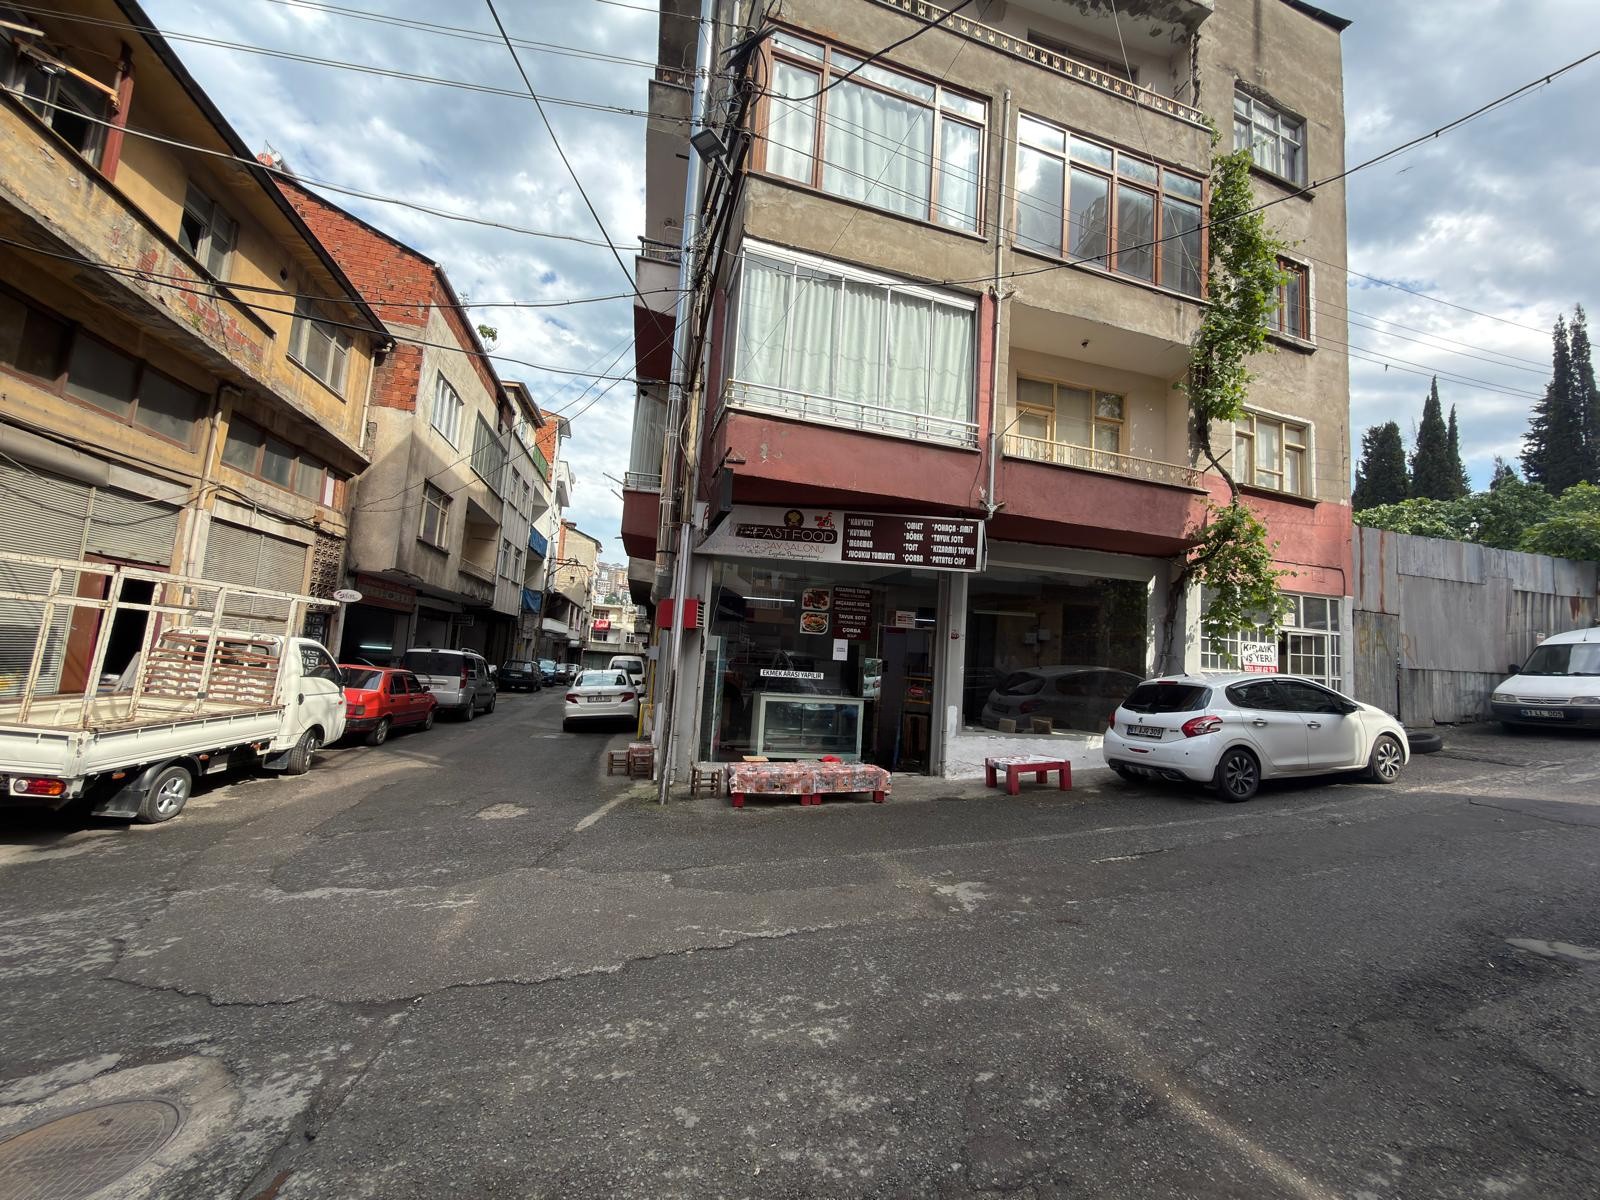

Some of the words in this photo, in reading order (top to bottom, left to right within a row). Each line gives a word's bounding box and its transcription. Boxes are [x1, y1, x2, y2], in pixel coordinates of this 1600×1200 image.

[906, 521, 924, 530] OMLET
[754, 527, 790, 539] FAST
[792, 530, 835, 542] FOOD
[906, 531, 924, 541] BÖREK
[934, 534, 950, 543] TAVUK
[951, 535, 964, 544] SOTE
[905, 543, 918, 551] TOST
[958, 546, 975, 555] TAVUK
[848, 550, 871, 559] SUCUKLU
[871, 551, 896, 561] YUMURTA
[904, 554, 924, 563] ÇORBA
[932, 555, 954, 564] PATATES
[783, 670, 800, 678] ARASI
[800, 671, 822, 679] YAPILIR
